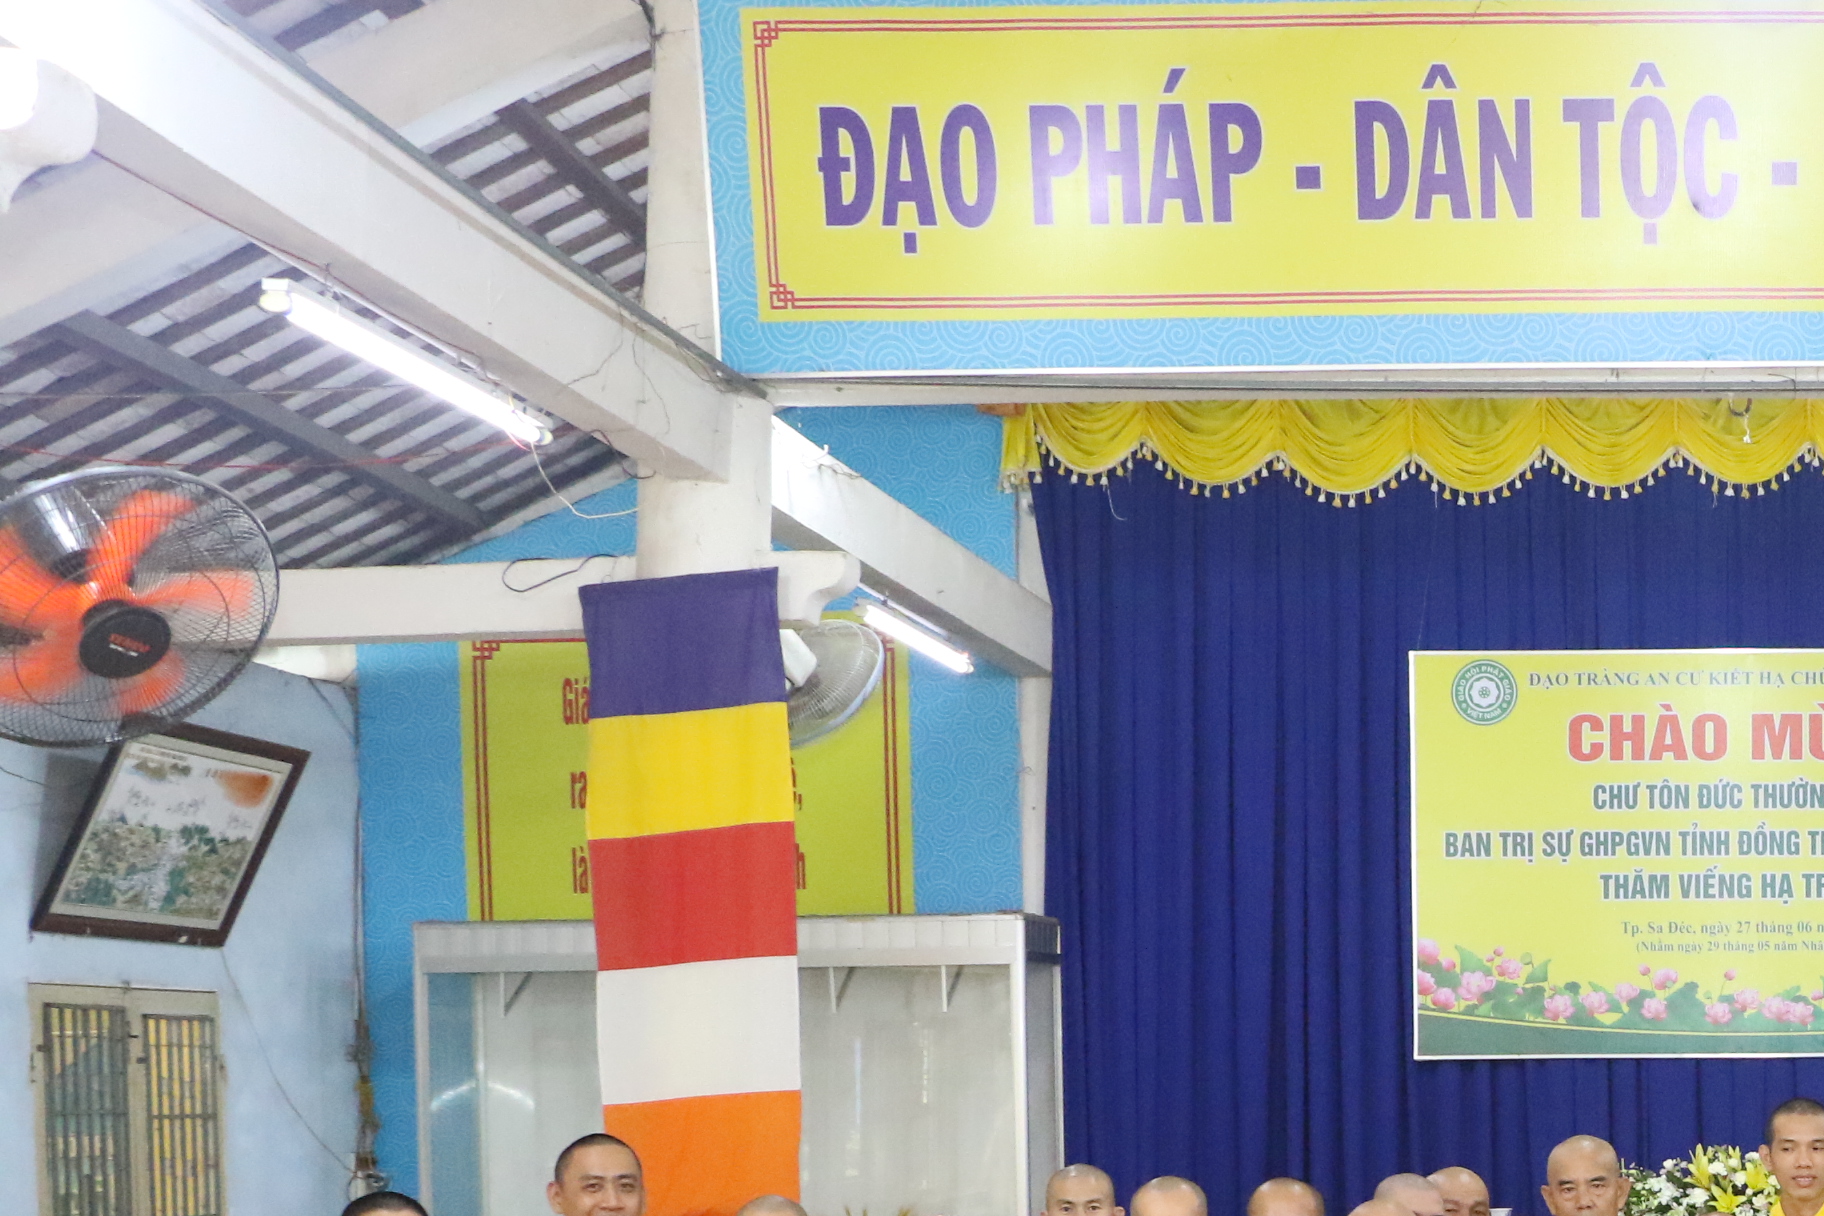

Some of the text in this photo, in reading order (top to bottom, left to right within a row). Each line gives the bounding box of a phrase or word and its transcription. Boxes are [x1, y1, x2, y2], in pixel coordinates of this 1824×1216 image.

[817, 102, 998, 255] ĐẠO
[1030, 67, 1264, 226] PHÁP
[1295, 164, 1322, 190] -
[1354, 62, 1533, 222] DÂN
[1563, 61, 1739, 245] TỘC
[1771, 161, 1797, 187] -
[1529, 671, 1569, 690] ĐẠO
[1574, 668, 1639, 686] TRÀNG
[1645, 671, 1670, 686] AN
[1676, 670, 1704, 686] CƯ
[1759, 670, 1785, 689] HẠ
[1568, 703, 1728, 762] CHÀO
[1593, 781, 1641, 810] CHƯ
[1646, 779, 1690, 810] TÔN
[1697, 778, 1743, 810] ĐỨC
[1444, 832, 1491, 858] BAN
[1499, 832, 1534, 863] TRỊ
[1542, 828, 1575, 863] SỰ
[1579, 831, 1671, 857] GHPGVN
[1679, 822, 1730, 856] TỈNH
[1737, 821, 1800, 856] ĐỒNG
[1600, 868, 1670, 900] THĂM
[1679, 865, 1752, 900] VIẾNG
[1761, 873, 1794, 905] HẠ
[1621, 921, 1643, 938] Tp.
[1647, 921, 1664, 934] Sa
[1701, 921, 1731, 936] ngày
[1736, 920, 1751, 934] 27
[1756, 920, 1794, 936] tháng
[1797, 920, 1812, 934] 06
[1678, 940, 1704, 954] ngày
[1707, 940, 1720, 952] 29
[1723, 940, 1755, 954] tháng
